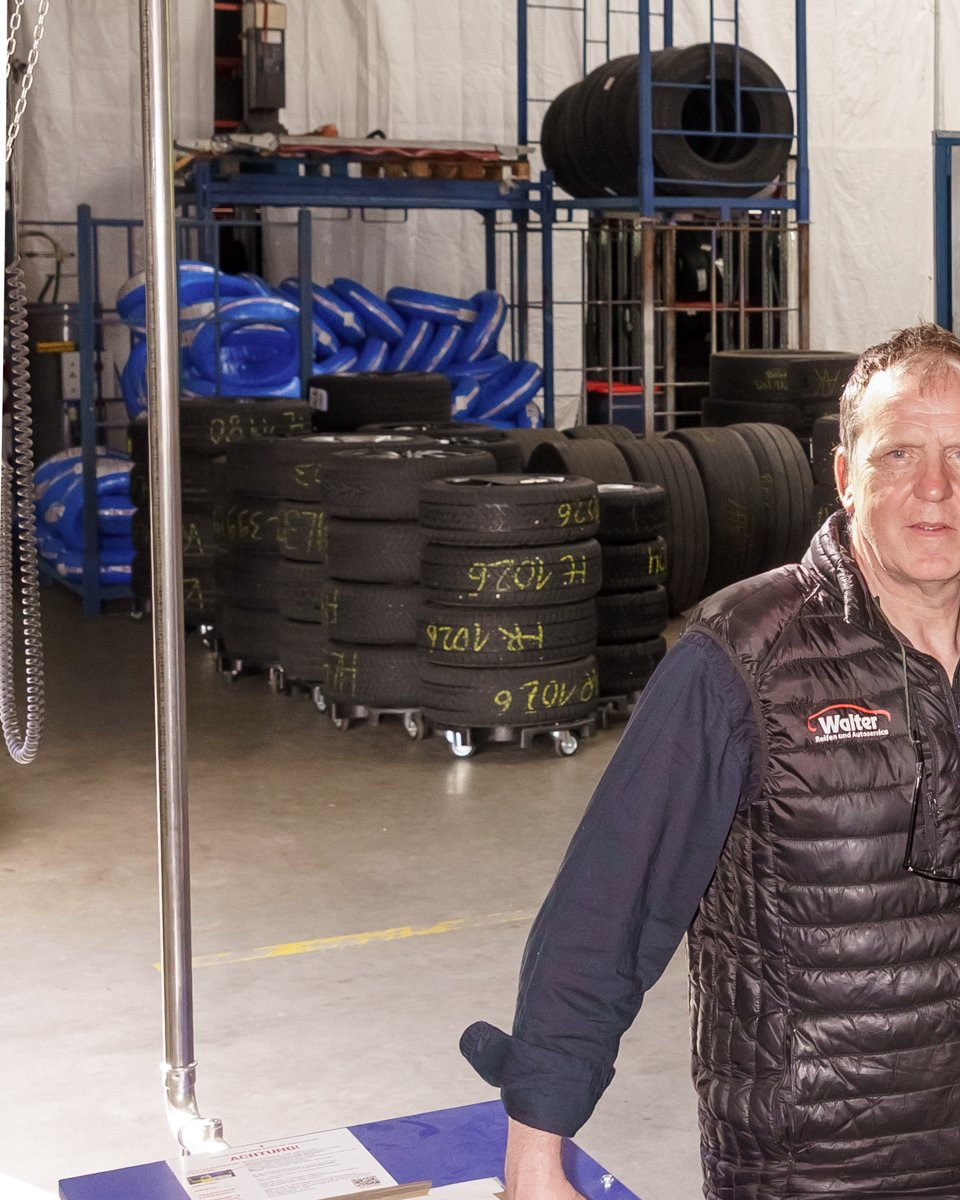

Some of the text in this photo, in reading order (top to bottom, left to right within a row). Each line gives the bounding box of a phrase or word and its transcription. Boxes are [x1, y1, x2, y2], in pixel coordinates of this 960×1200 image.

[818, 713, 878, 735] Walter
[815, 729, 889, 743] Reifen und Autoservice
